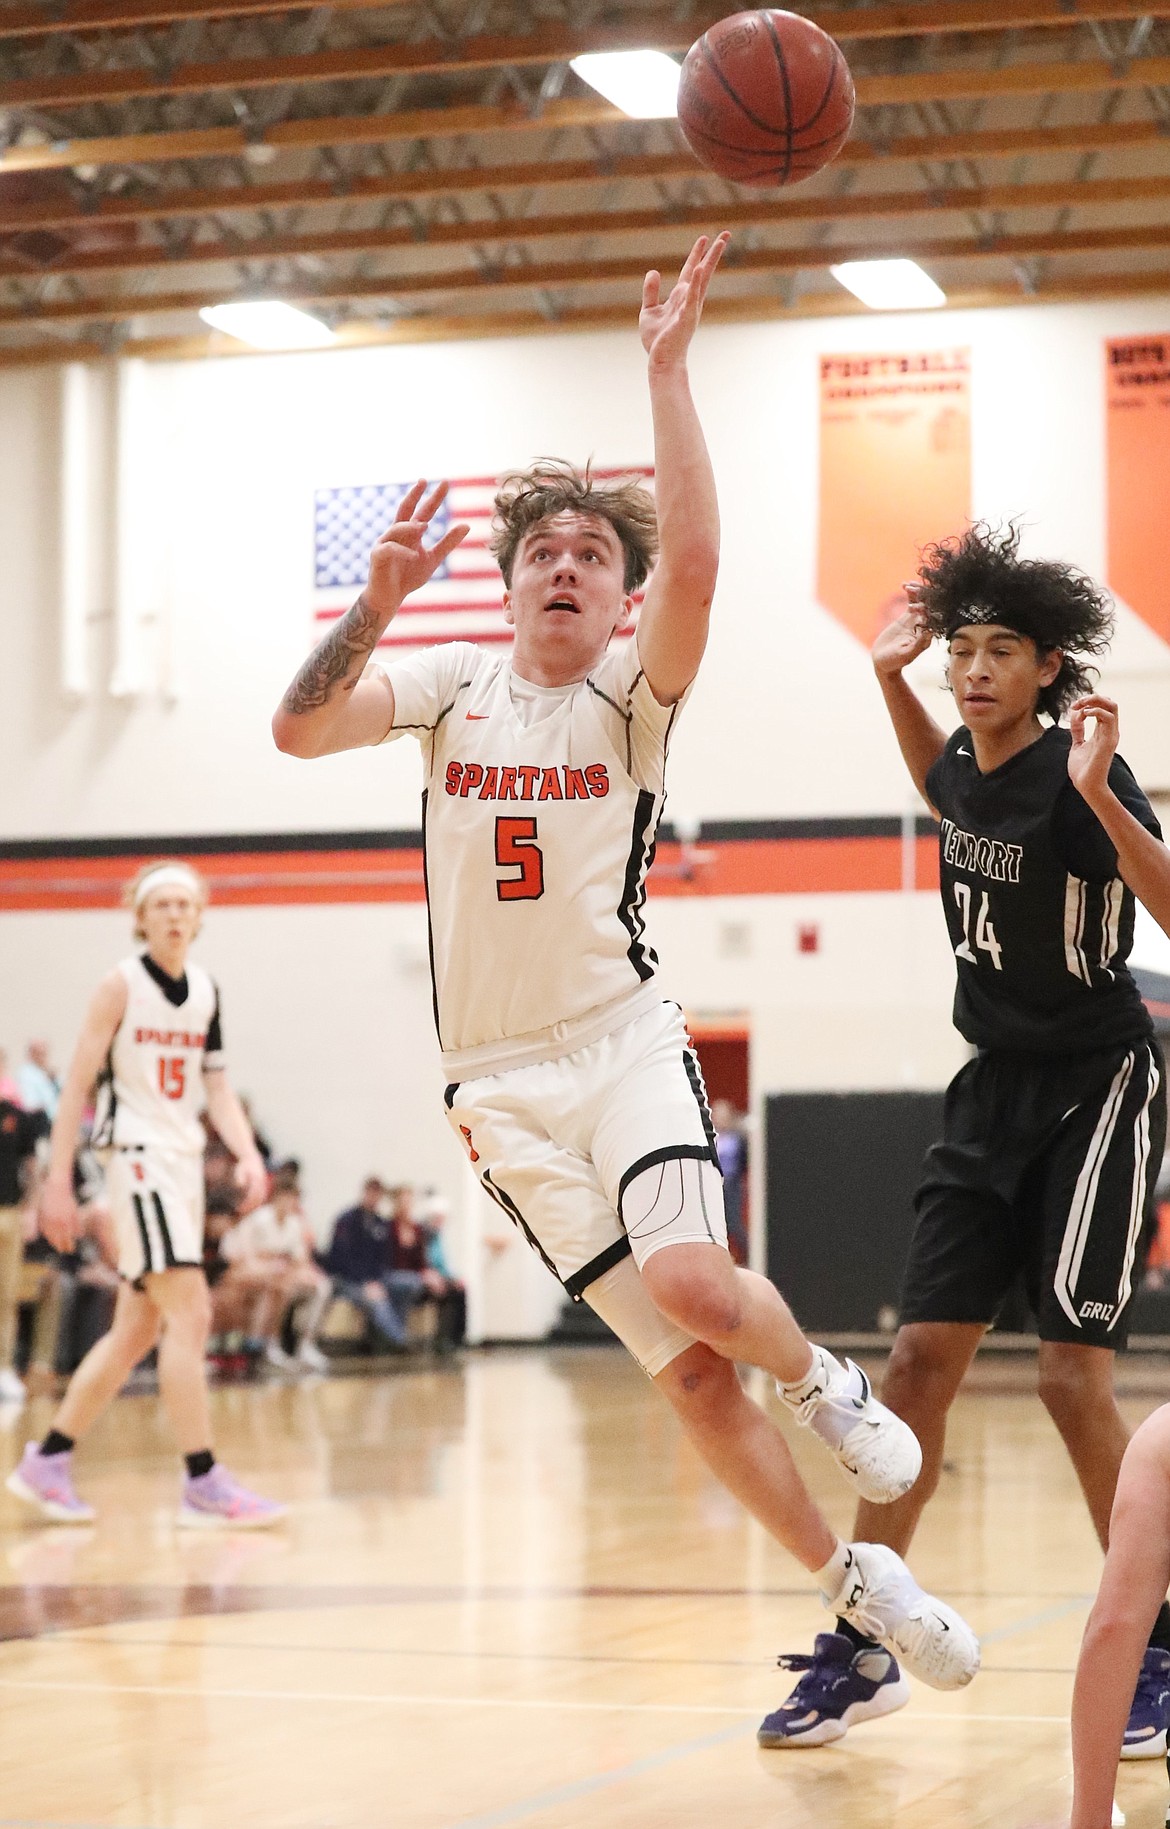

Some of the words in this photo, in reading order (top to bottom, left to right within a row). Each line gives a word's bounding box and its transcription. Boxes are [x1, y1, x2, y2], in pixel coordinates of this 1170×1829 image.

[445, 761, 610, 801] SPARTANS
[494, 816, 545, 902] 5
[953, 881, 1003, 971] 24
[158, 1056, 185, 1100] 15
[1078, 1300, 1115, 1322] GRIZ
